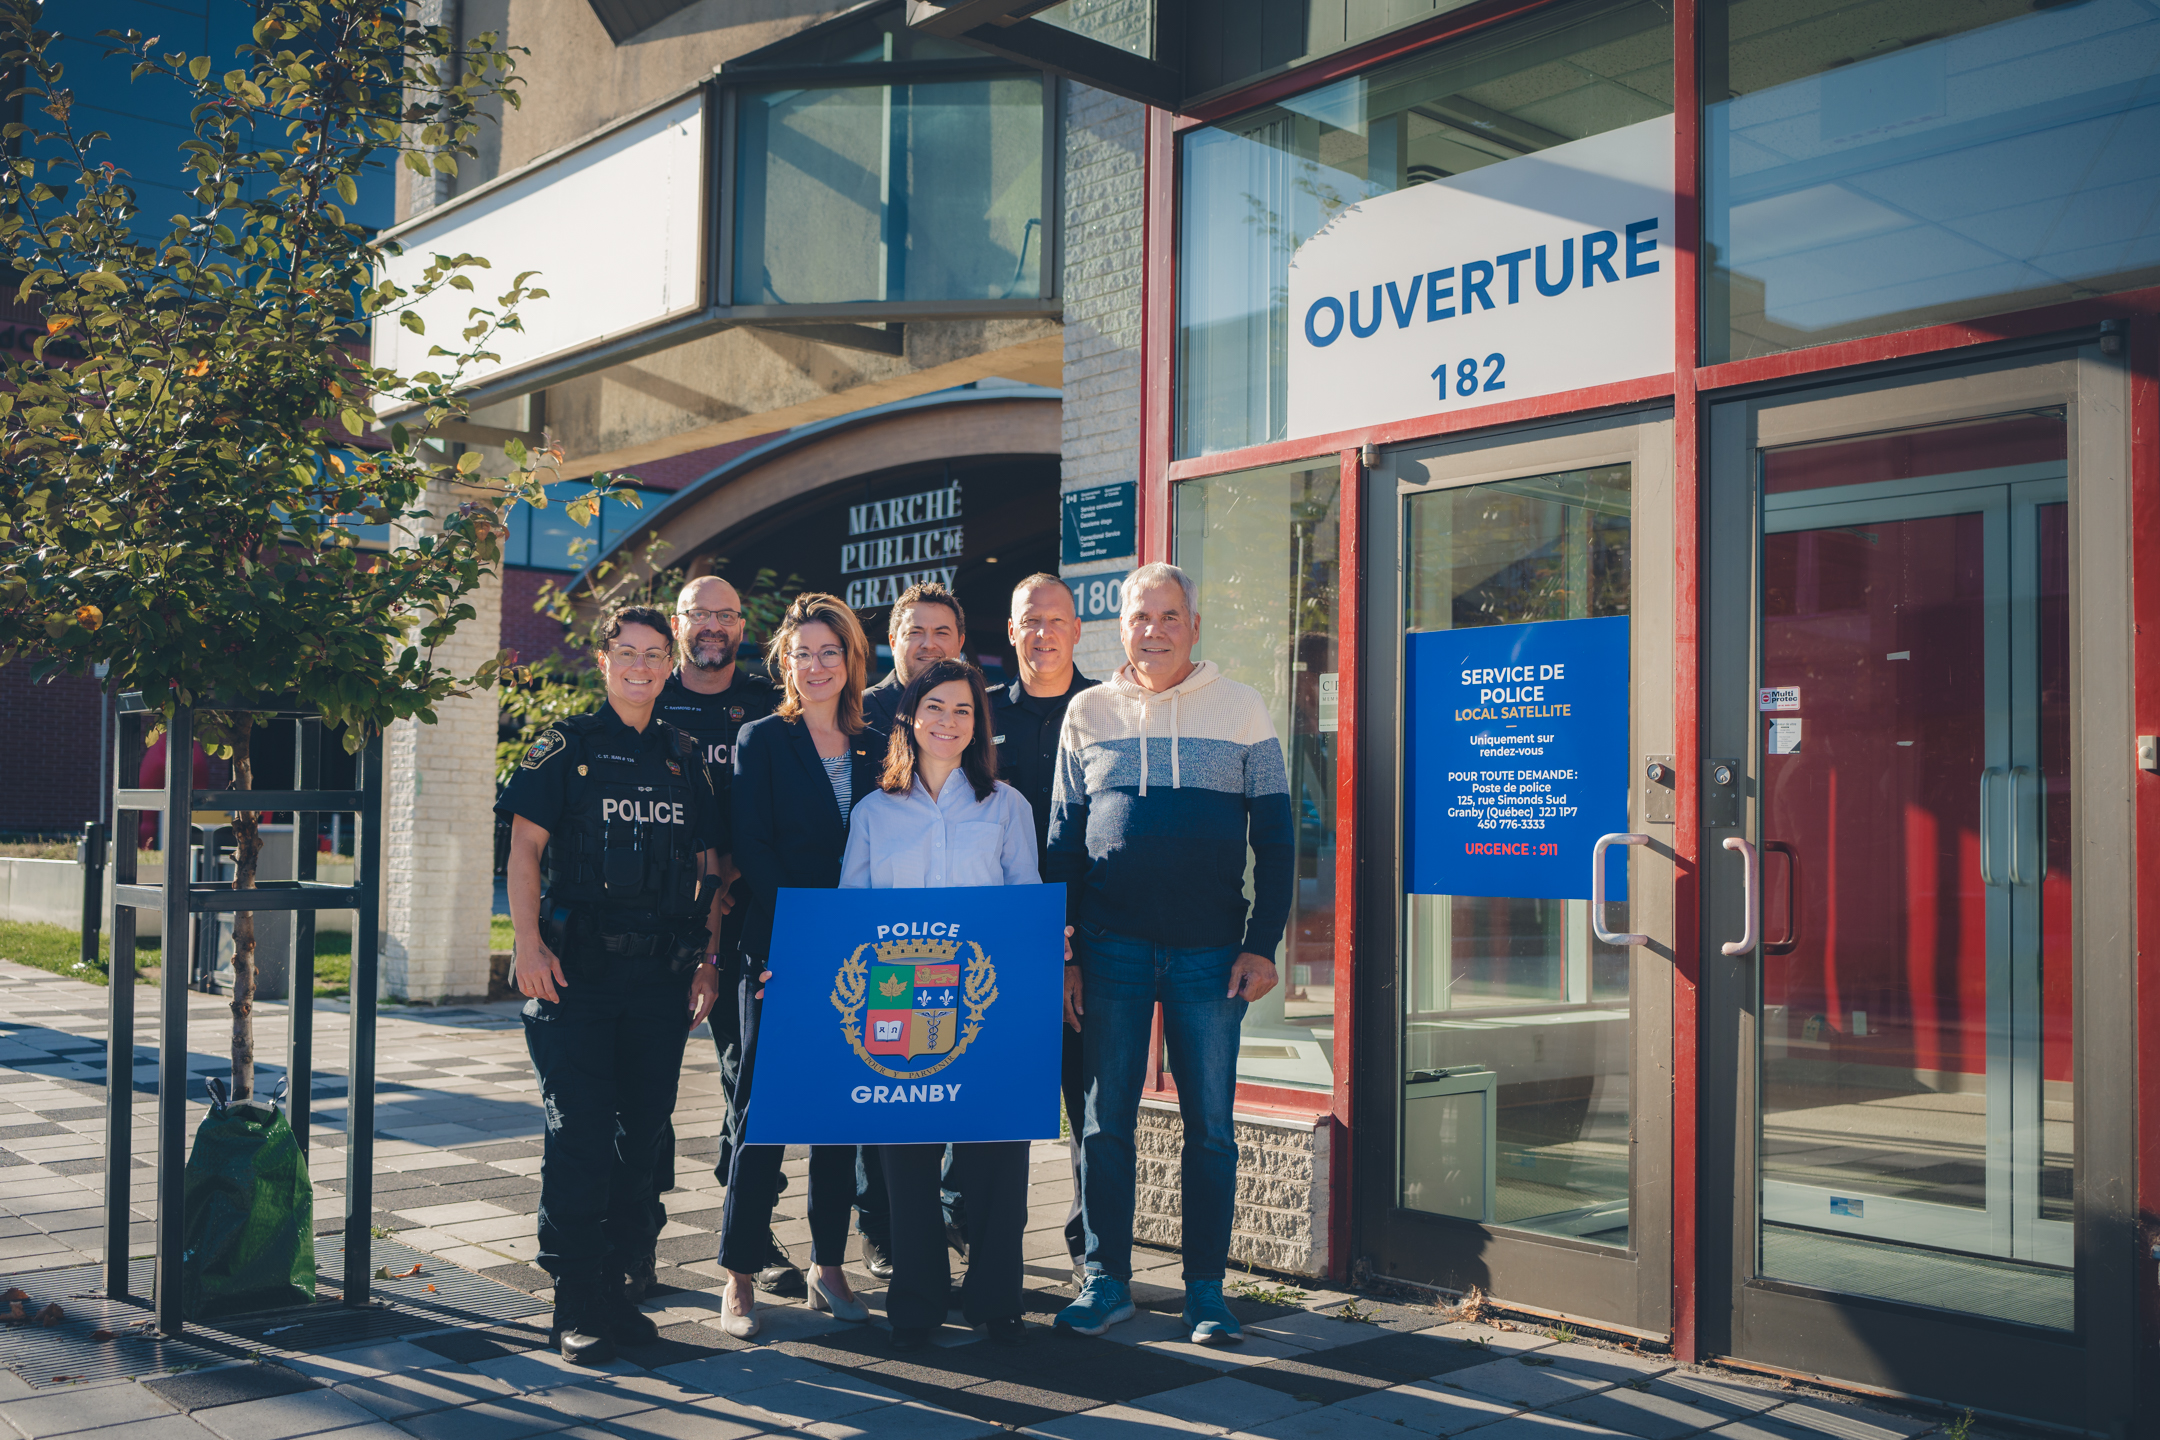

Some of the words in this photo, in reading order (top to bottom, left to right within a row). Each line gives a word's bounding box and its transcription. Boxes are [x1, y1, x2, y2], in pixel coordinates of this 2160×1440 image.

[1305, 217, 1660, 348] OUVERTURE
[1431, 352, 1506, 400] 182
[849, 479, 963, 535] MARCHÉ
[1080, 533, 1104, 542] Correctional
[841, 529, 940, 574] PUBLIC
[943, 525, 964, 556] DE
[1080, 550, 1095, 558] Second
[1074, 579, 1121, 616] 180
[1461, 666, 1534, 685] SERVICE
[1540, 664, 1564, 680] DE
[1481, 686, 1544, 704] POLICE
[1455, 708, 1498, 721] LOCAL
[1501, 704, 1571, 719] SATELLITE
[1470, 734, 1534, 747] Uniquement
[1537, 734, 1554, 743] sur
[1480, 746, 1543, 757] rendez-vous
[1448, 772, 1478, 781] POUR
[1480, 771, 1514, 781] TOUTE
[1472, 783, 1500, 793] Poste
[1503, 782, 1516, 793] de
[1520, 782, 1551, 794] police
[1457, 796, 1475, 806] 125,
[1478, 797, 1495, 805] rue
[1497, 794, 1543, 805] Simonds
[1546, 794, 1567, 805] Sud
[602, 798, 684, 824] POLICE
[1448, 807, 1484, 819] Granby
[1487, 807, 1533, 819] (Québec)
[1539, 807, 1556, 817] J2J
[1559, 807, 1578, 817] 1P7
[1477, 820, 1497, 829] 450
[1499, 820, 1545, 829] 776-3333
[1465, 843, 1529, 855] URGENCE
[1539, 843, 1558, 856] 911
[877, 922, 960, 939] POLICE
[864, 1056, 886, 1074] POUR
[908, 1055, 955, 1078] PARVENIR
[851, 1084, 962, 1103] GRANBY
